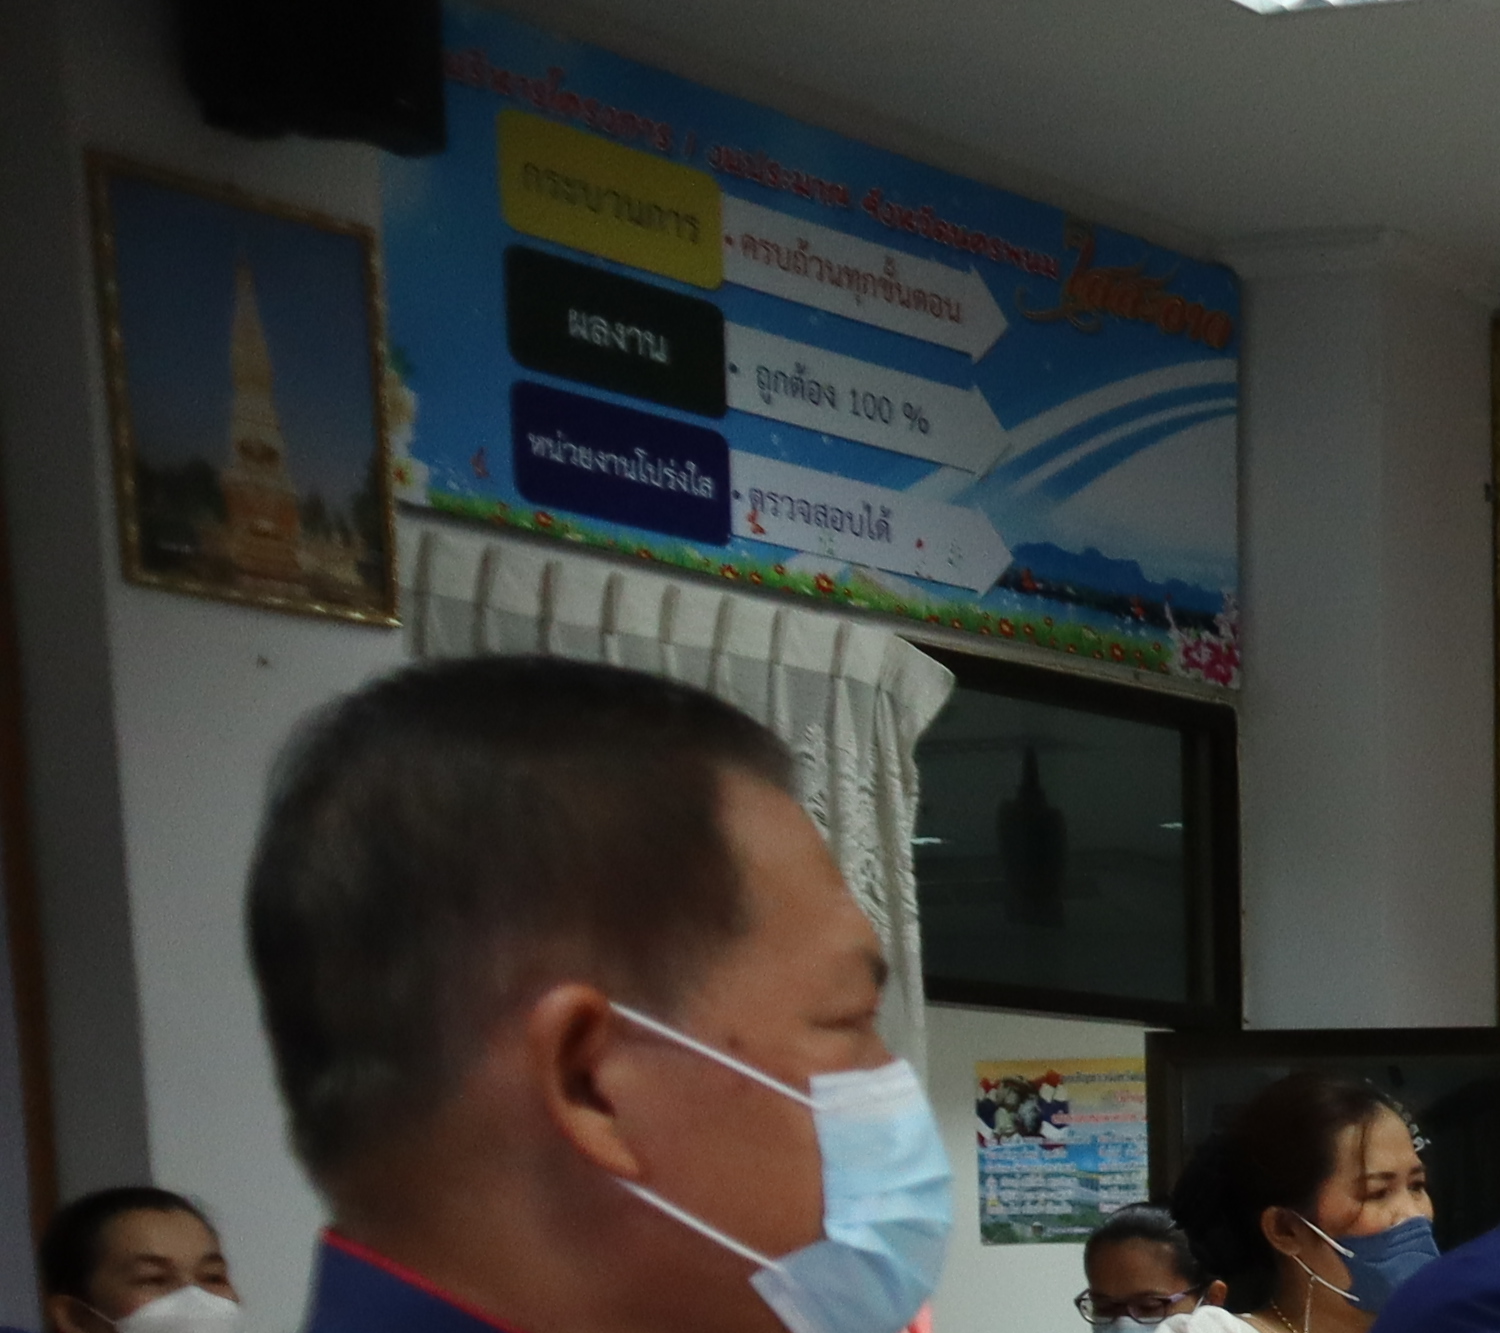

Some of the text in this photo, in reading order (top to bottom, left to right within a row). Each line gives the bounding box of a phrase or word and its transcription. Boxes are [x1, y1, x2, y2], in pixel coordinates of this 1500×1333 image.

[521, 161, 700, 245] กระบวนการ
[740, 235, 964, 325] ครบถ้วนทุกขั้นตอน
[567, 305, 672, 366] ผลงาน
[755, 361, 930, 435] ถูกต้อง 100 %
[527, 429, 716, 500] หน่วยงานโปร่งใส
[748, 486, 894, 544] ตรวจสอบได้
